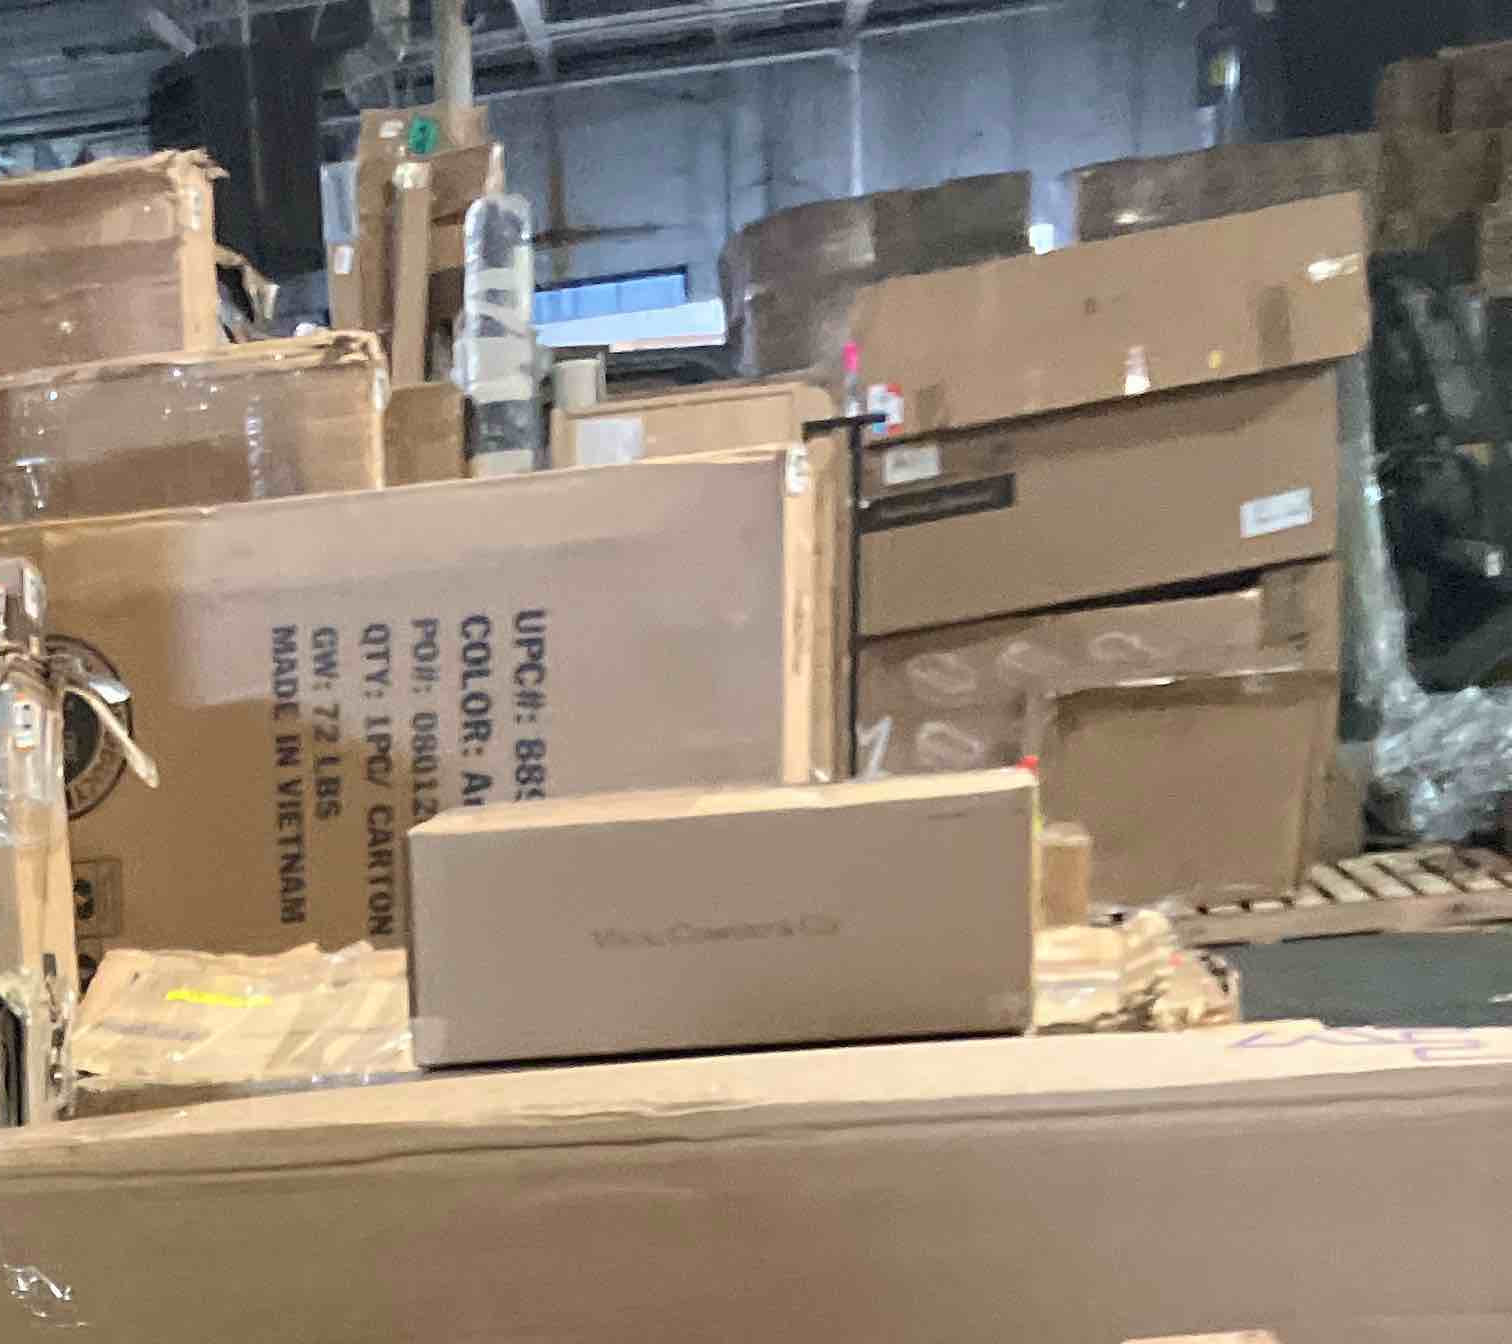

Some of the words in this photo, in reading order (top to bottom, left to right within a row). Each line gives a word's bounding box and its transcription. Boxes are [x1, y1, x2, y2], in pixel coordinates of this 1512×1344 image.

[272, 624, 299, 721] MADE
[312, 626, 339, 690] GW:
[360, 623, 391, 699] QTY:
[460, 614, 492, 757] COLOR:
[276, 735, 302, 768] IN
[277, 776, 306, 924] VIETNAM
[367, 804, 393, 936] CARTON
